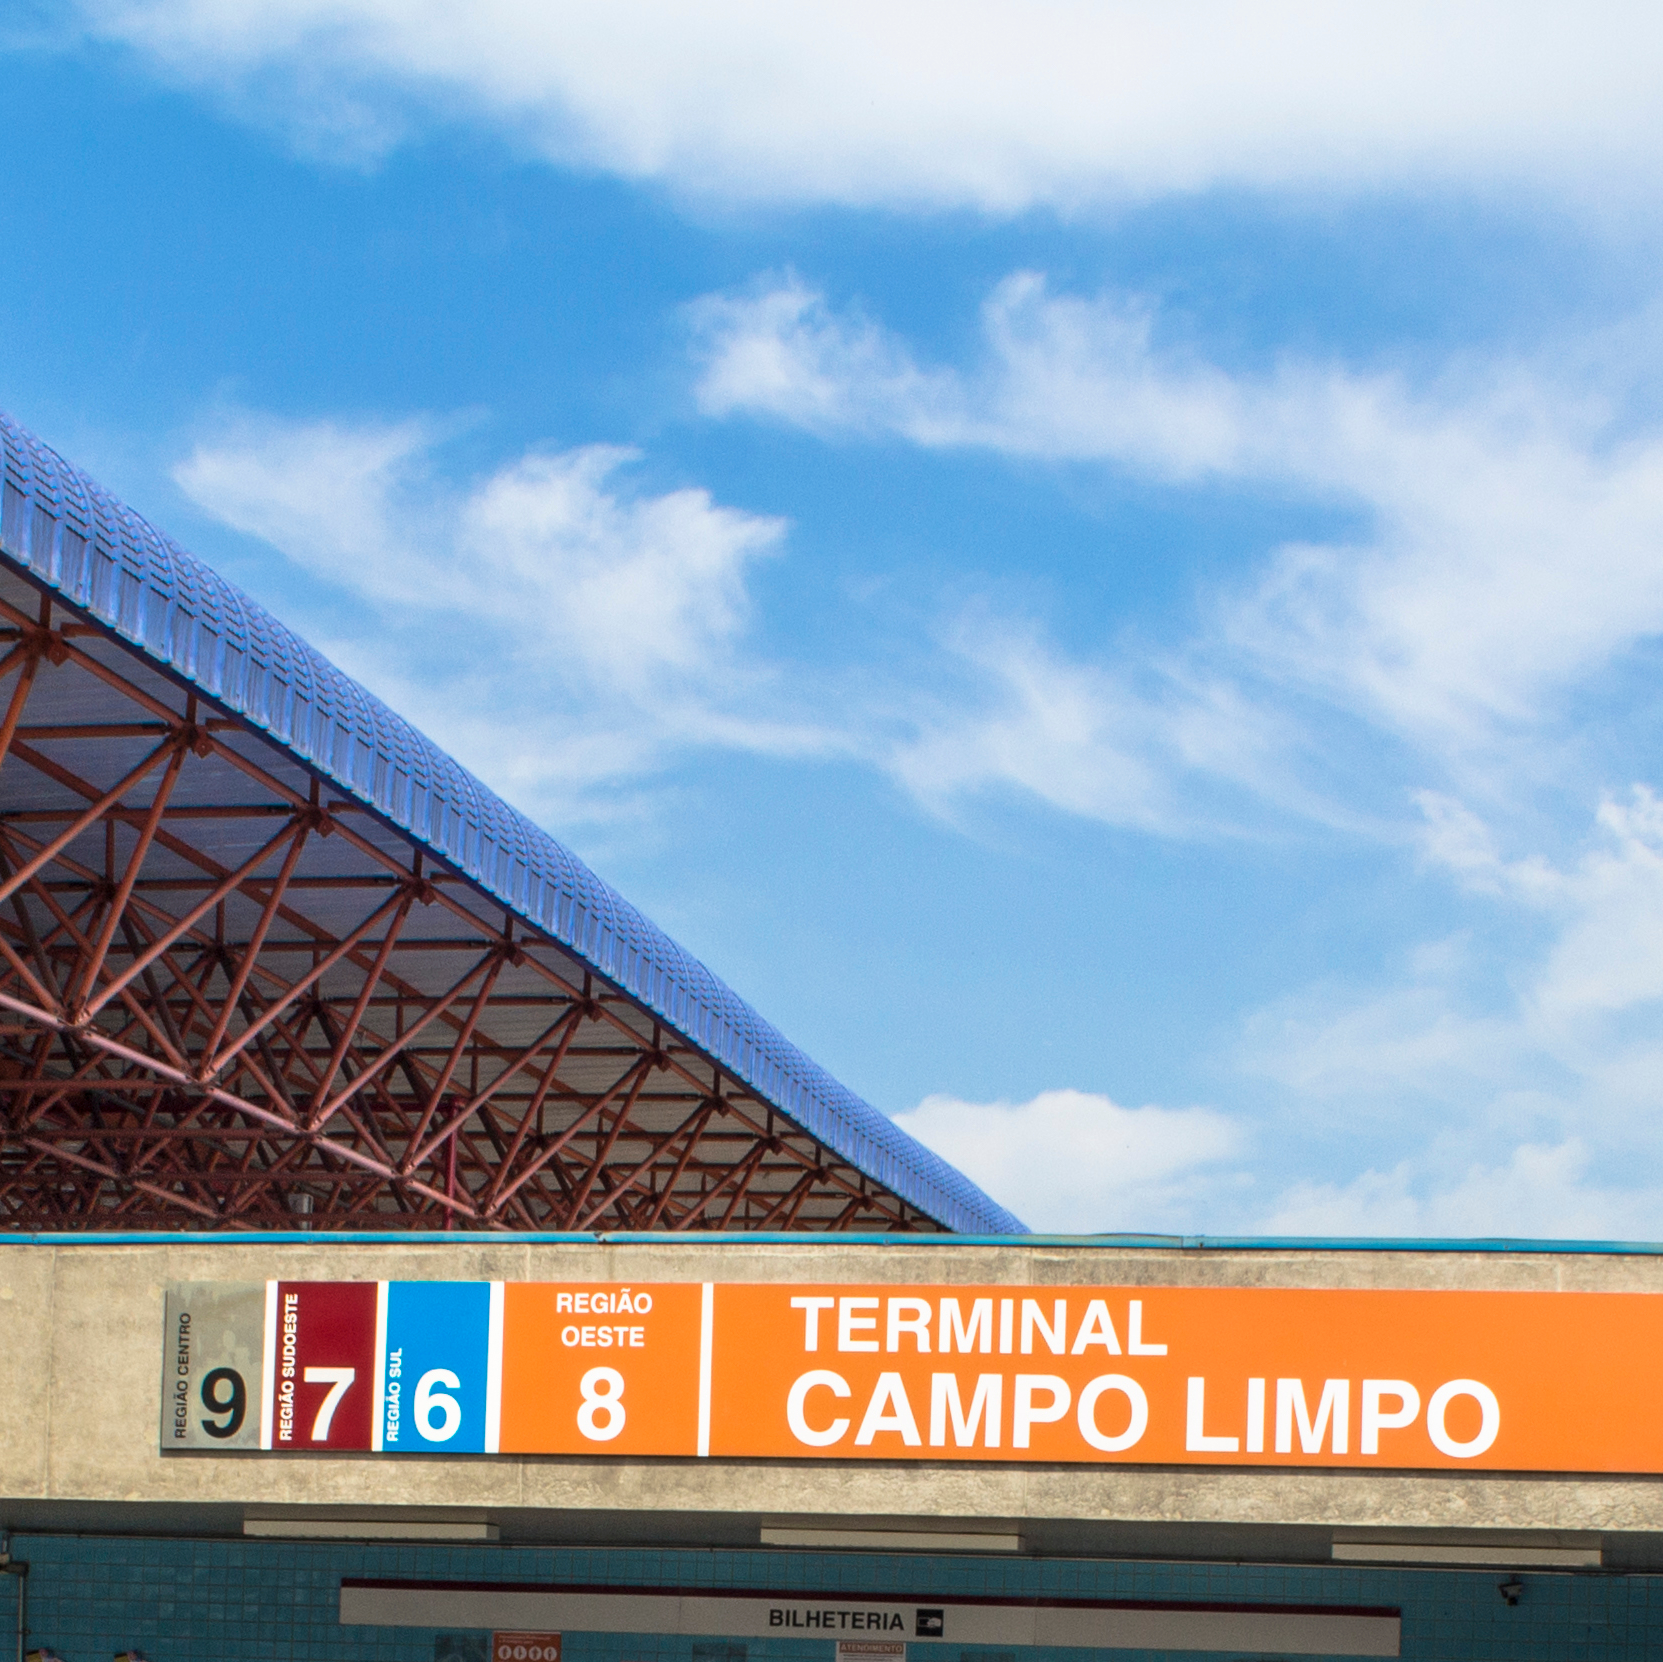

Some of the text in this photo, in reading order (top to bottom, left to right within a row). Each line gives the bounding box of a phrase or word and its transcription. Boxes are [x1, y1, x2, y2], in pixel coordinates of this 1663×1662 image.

[555, 1288, 653, 1314] REGIÃO
[560, 1325, 645, 1347] OESTE
[790, 1296, 1169, 1356] TERMINAL
[174, 1312, 192, 1439] REGIÃO CENTRO
[201, 1367, 247, 1439] 9
[279, 1293, 299, 1441] REGIÃO SUDOESTE
[303, 1366, 356, 1441] 7
[386, 1348, 403, 1442] REGIÃO SUL
[576, 1366, 627, 1441] 8
[413, 1368, 462, 1442] 6
[786, 1369, 1501, 1459] CAMPO LIMPO
[769, 1609, 905, 1631] BILHETERIA
[840, 1642, 903, 1653] ATENDIMENTO
